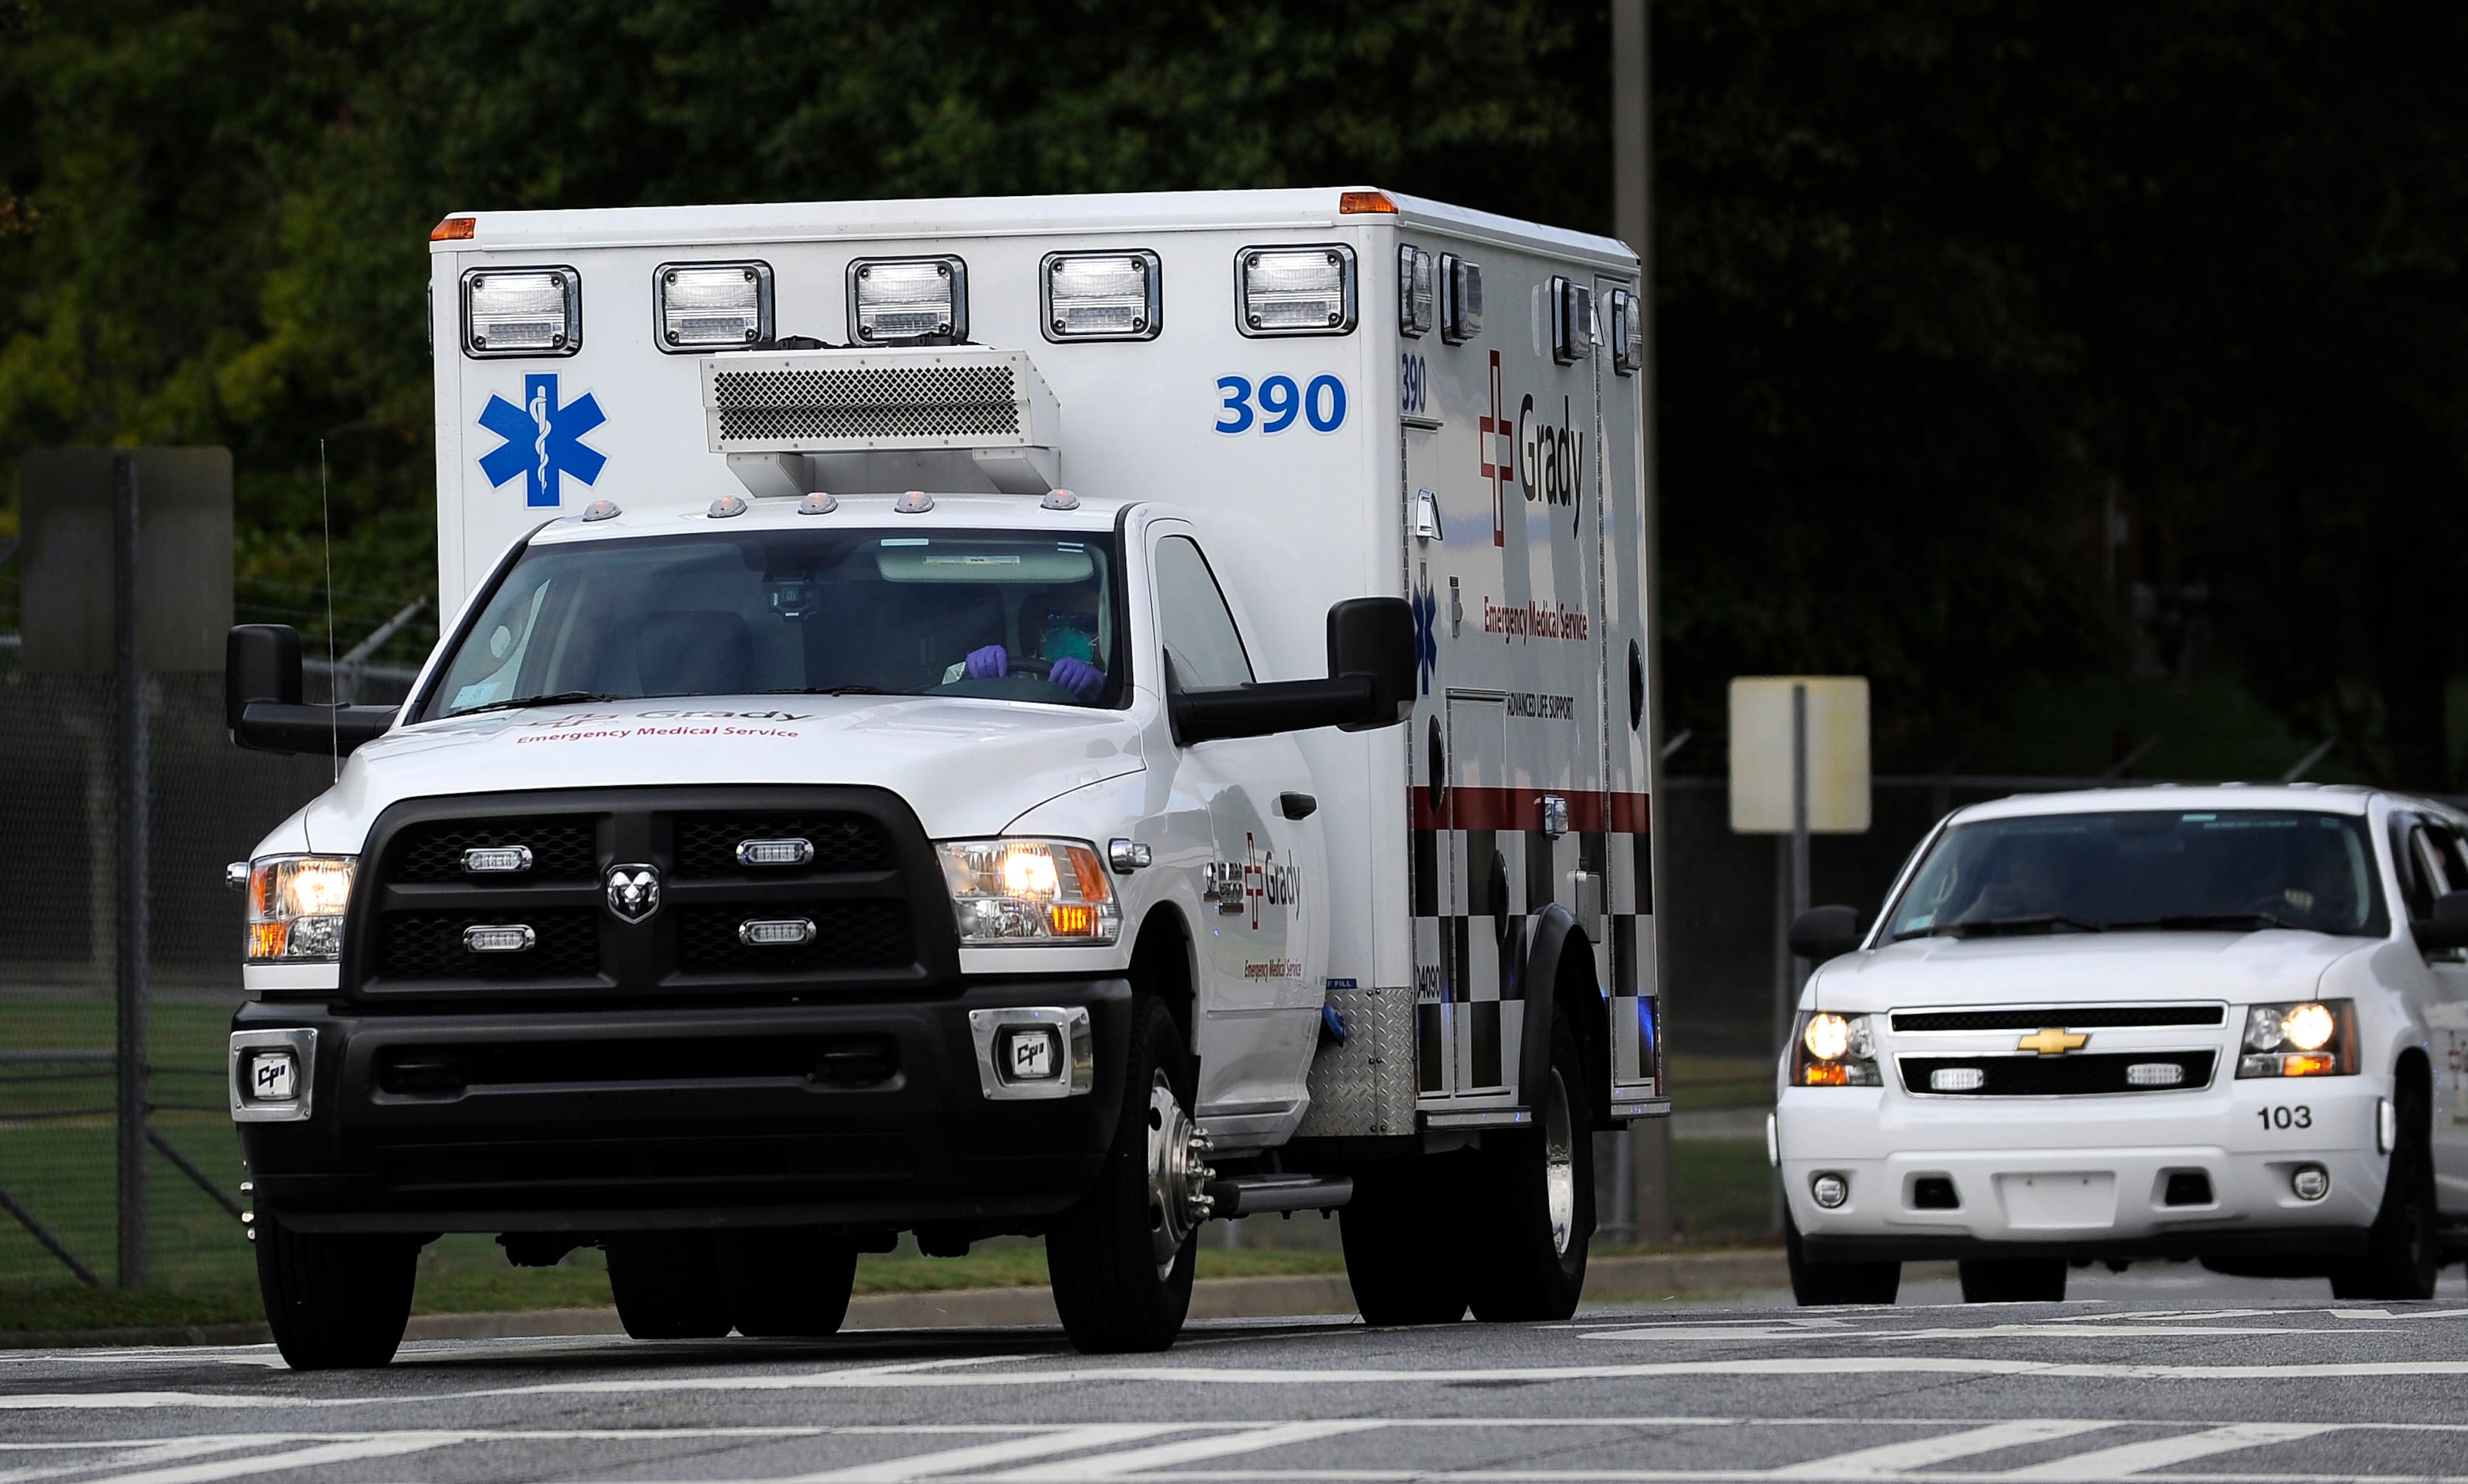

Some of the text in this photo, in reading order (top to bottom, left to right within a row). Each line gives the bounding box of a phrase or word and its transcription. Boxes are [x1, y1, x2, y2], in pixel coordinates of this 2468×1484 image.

[1402, 353, 1427, 413] 390
[1215, 374, 1347, 434] 390
[1519, 393, 1584, 539] Grady
[1484, 595, 1587, 646] Emergency Medical Service
[636, 710, 816, 722] Grady
[1507, 692, 1574, 720] ADVANCED LIFE SUPPORT
[516, 726, 799, 744] Emergency Medical Service
[1265, 848, 1300, 922] Grady
[1245, 958, 1301, 983] Emergency Medical Service
[2257, 1105, 2312, 1131] 103
